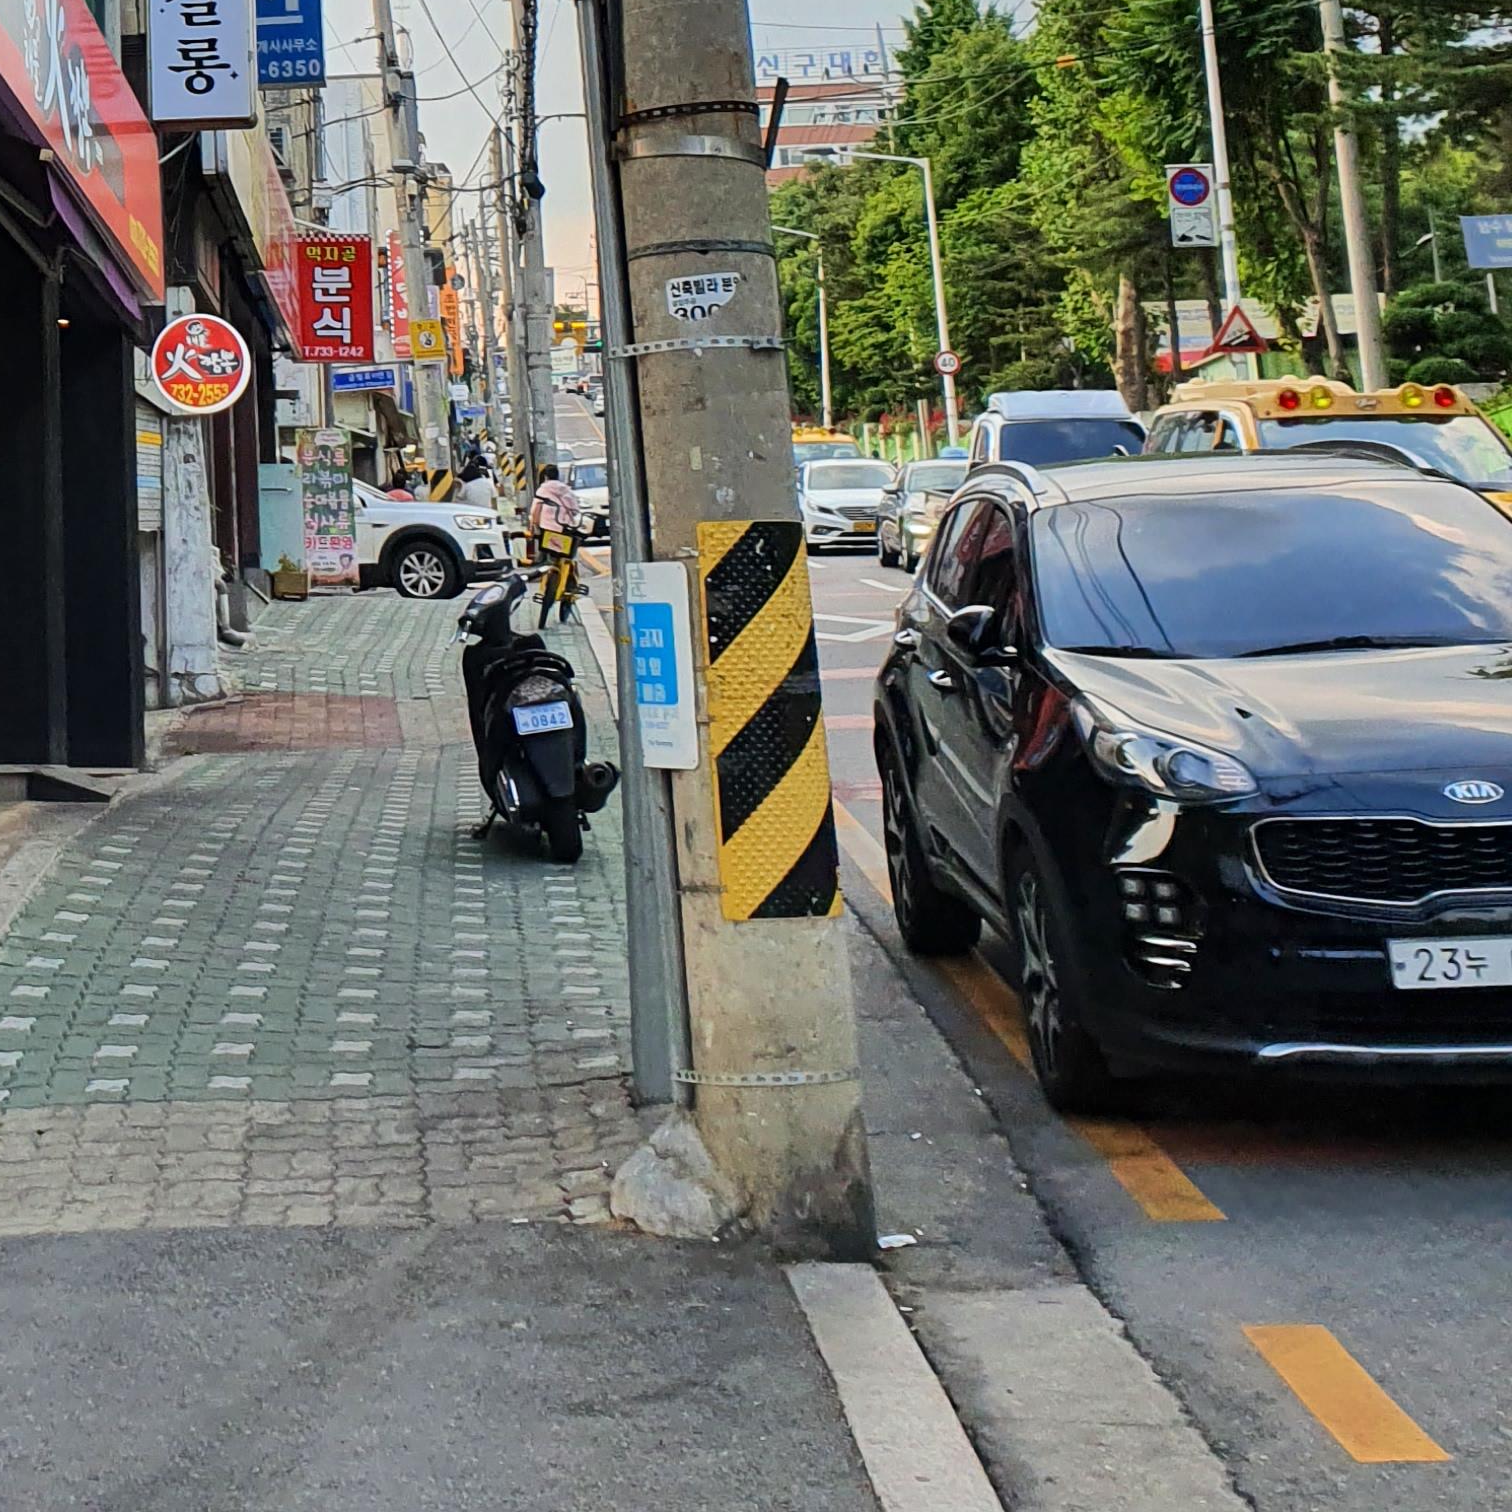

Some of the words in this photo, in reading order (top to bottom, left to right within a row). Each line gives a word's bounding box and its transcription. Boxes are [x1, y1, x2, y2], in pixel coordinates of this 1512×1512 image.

[670, 276, 718, 299] 신축빌라
[311, 265, 353, 345] 분식
[160, 342, 204, 381] 火
[169, 383, 230, 406] 732-2553
[1453, 784, 1498, 799] KIA
[1413, 947, 1490, 982] 23누
